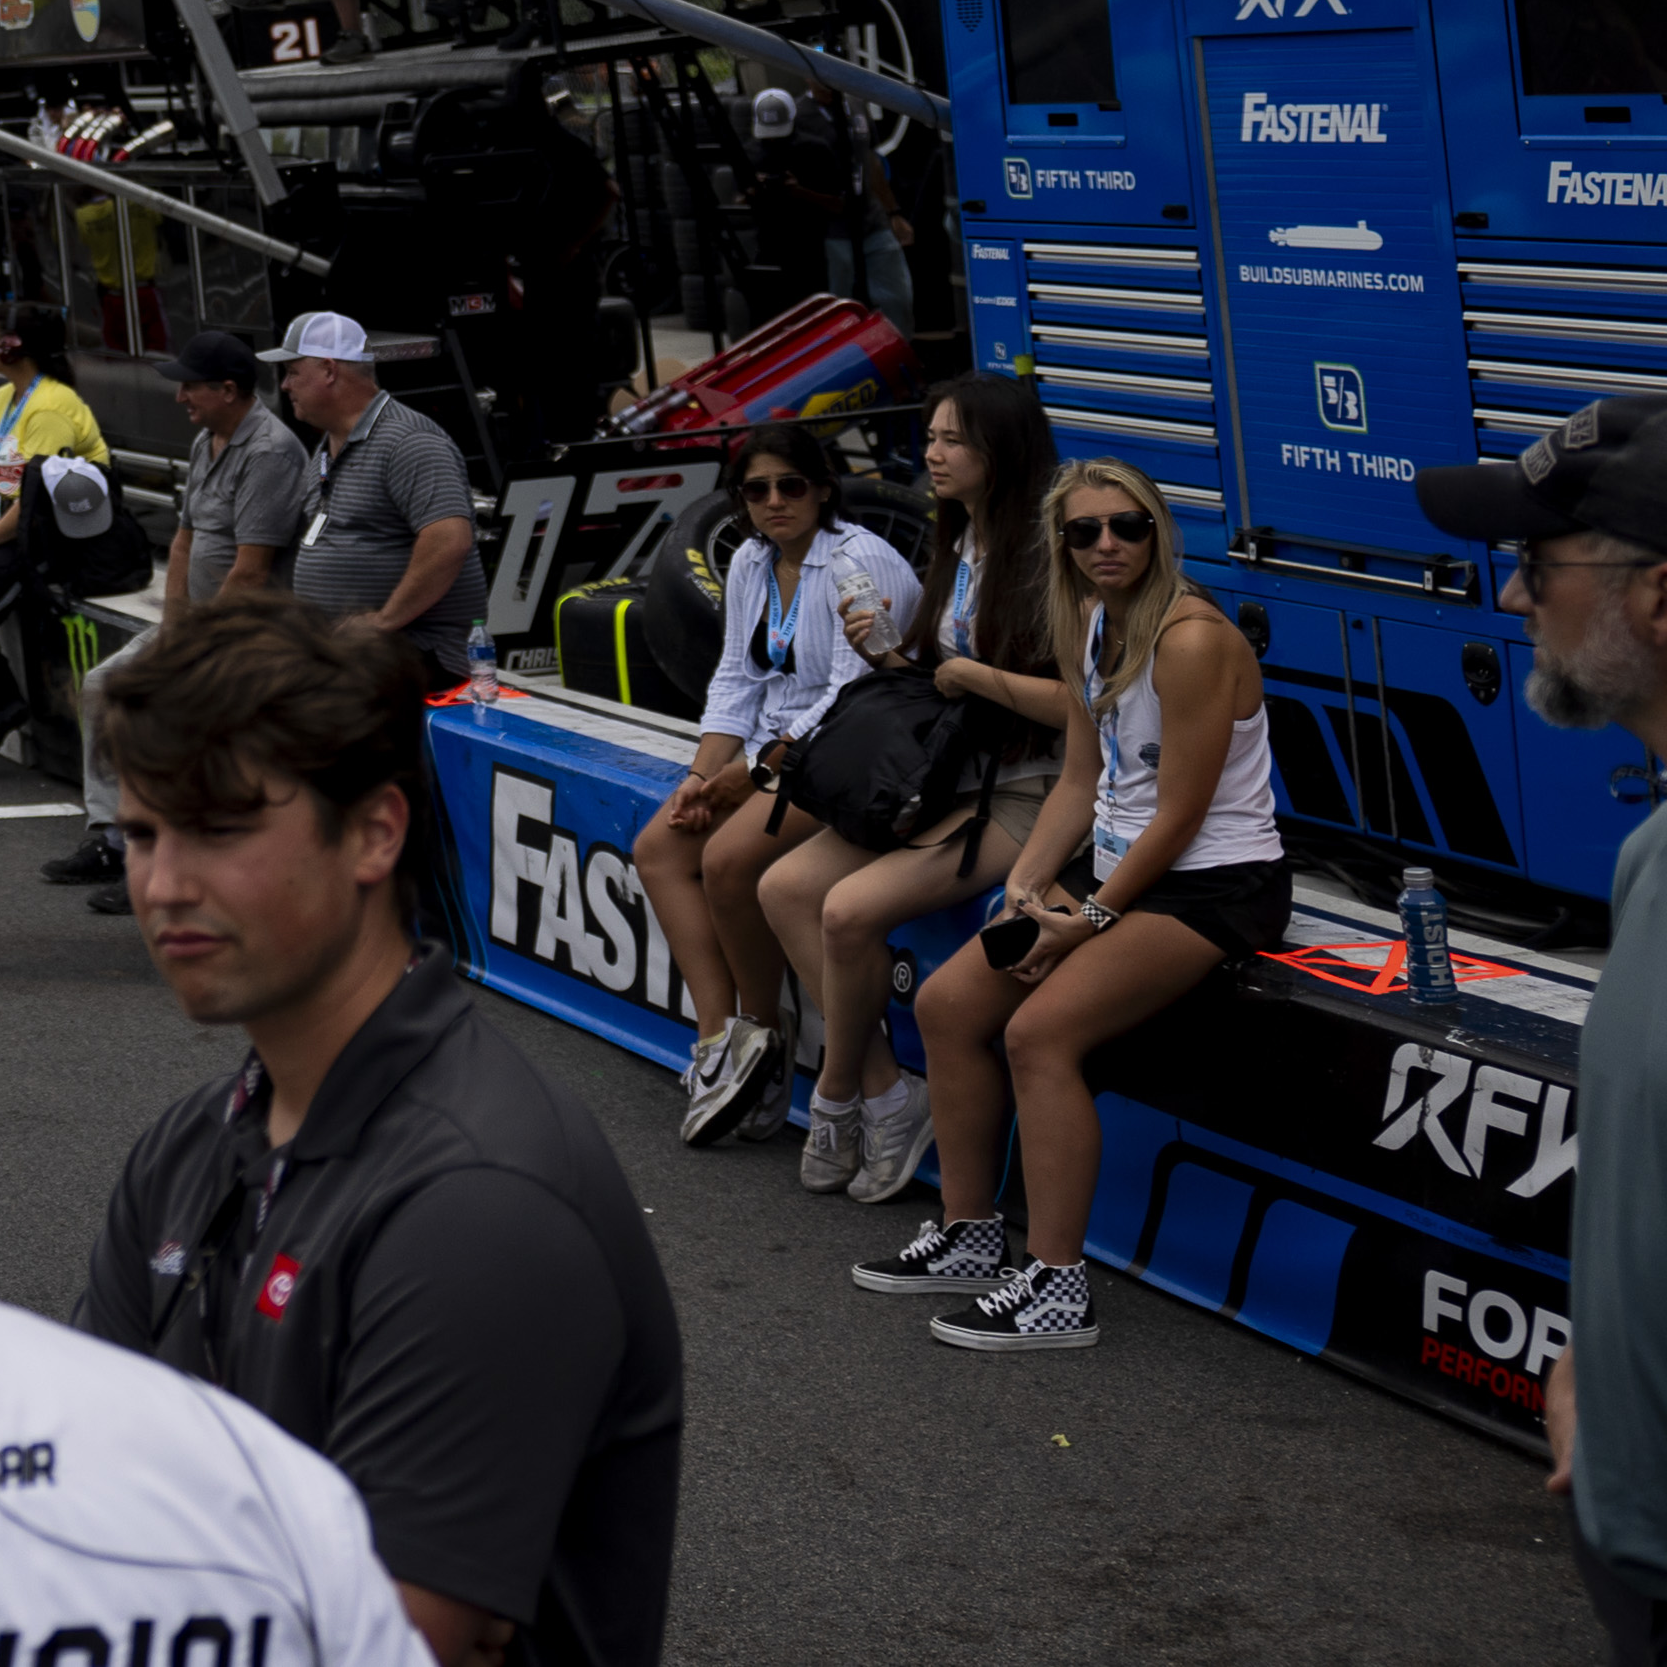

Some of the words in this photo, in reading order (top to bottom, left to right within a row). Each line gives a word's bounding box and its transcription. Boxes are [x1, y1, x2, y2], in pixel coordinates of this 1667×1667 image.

[270, 17, 320, 63] 21
[1240, 91, 1388, 144] FASTENAL
[1035, 169, 1082, 190] FIFTH
[1084, 170, 1137, 191] THIRD
[1547, 161, 1667, 207] FASTENA
[1238, 265, 1425, 293] BUILDSUBMARINES.COM
[1281, 442, 1342, 473] FIFTH
[1347, 452, 1417, 483] THIRD
[486, 460, 724, 635] 17
[1422, 910, 1452, 987] HOIST
[1371, 1042, 1580, 1199] RFK
